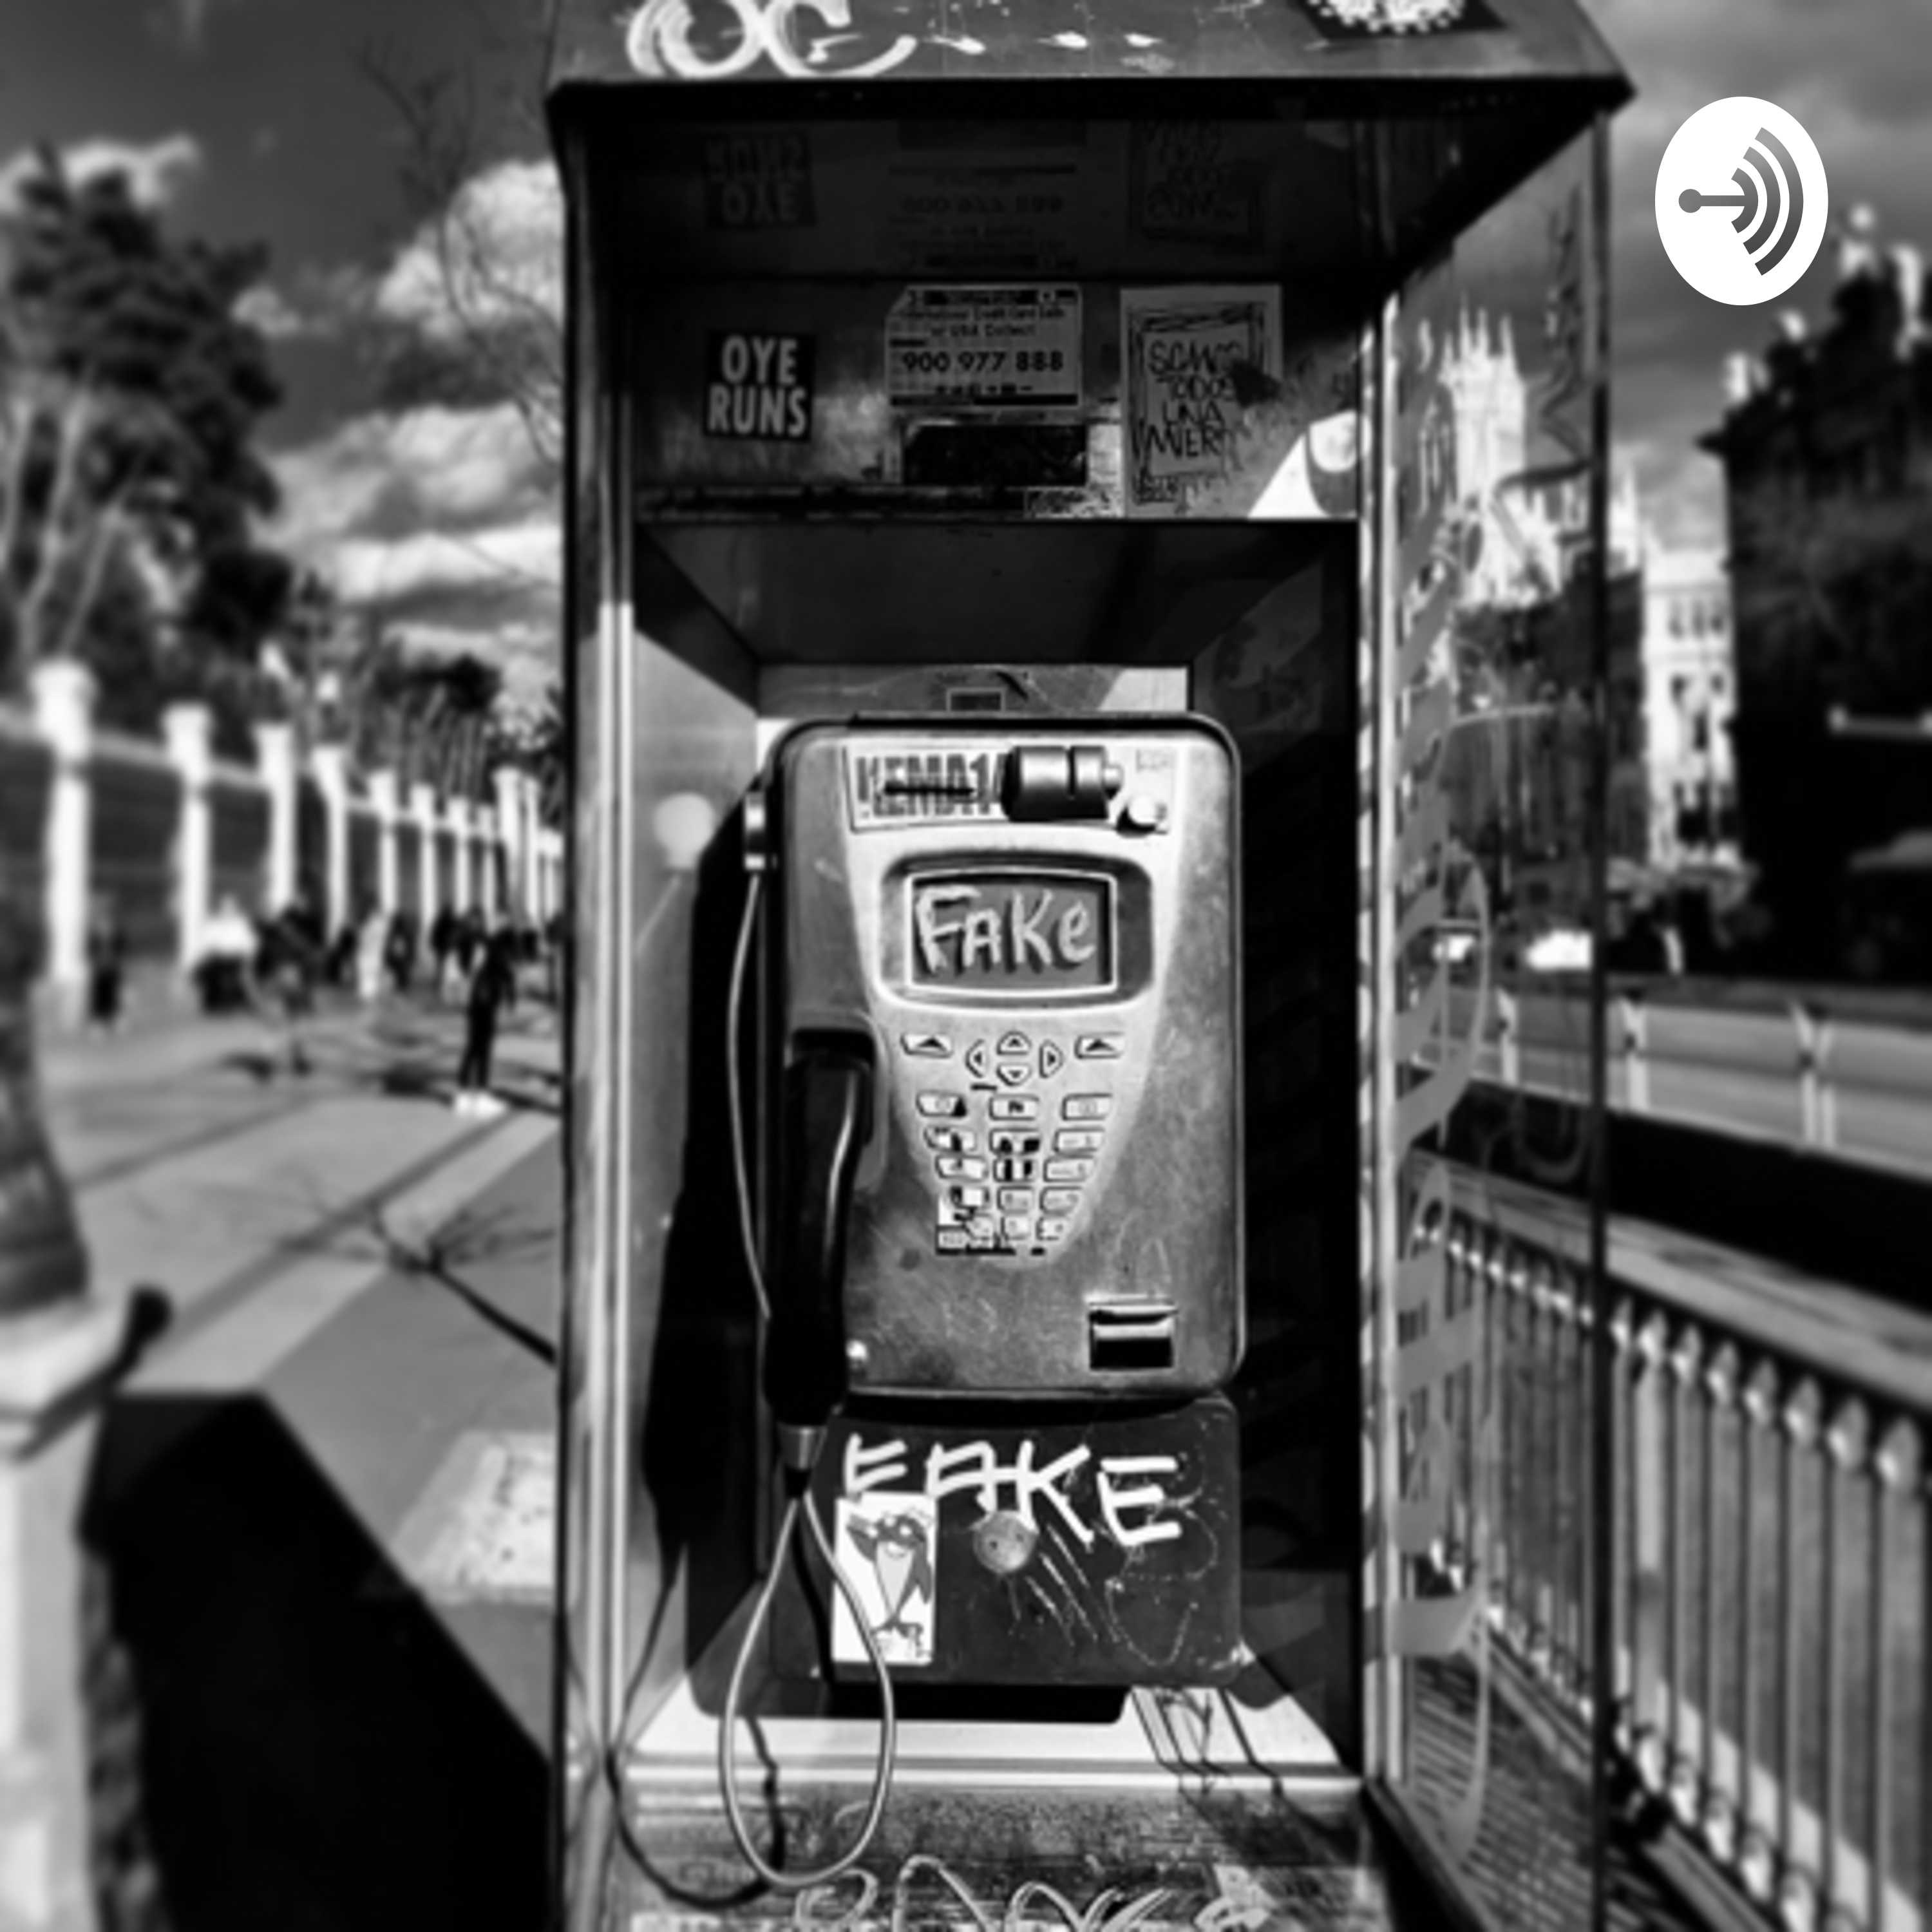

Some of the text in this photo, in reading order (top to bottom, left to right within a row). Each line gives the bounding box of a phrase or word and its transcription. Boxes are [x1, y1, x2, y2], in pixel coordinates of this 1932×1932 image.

[721, 335, 797, 385] OYE
[902, 350, 1064, 372] 900 977 888
[708, 386, 807, 437] RUNS
